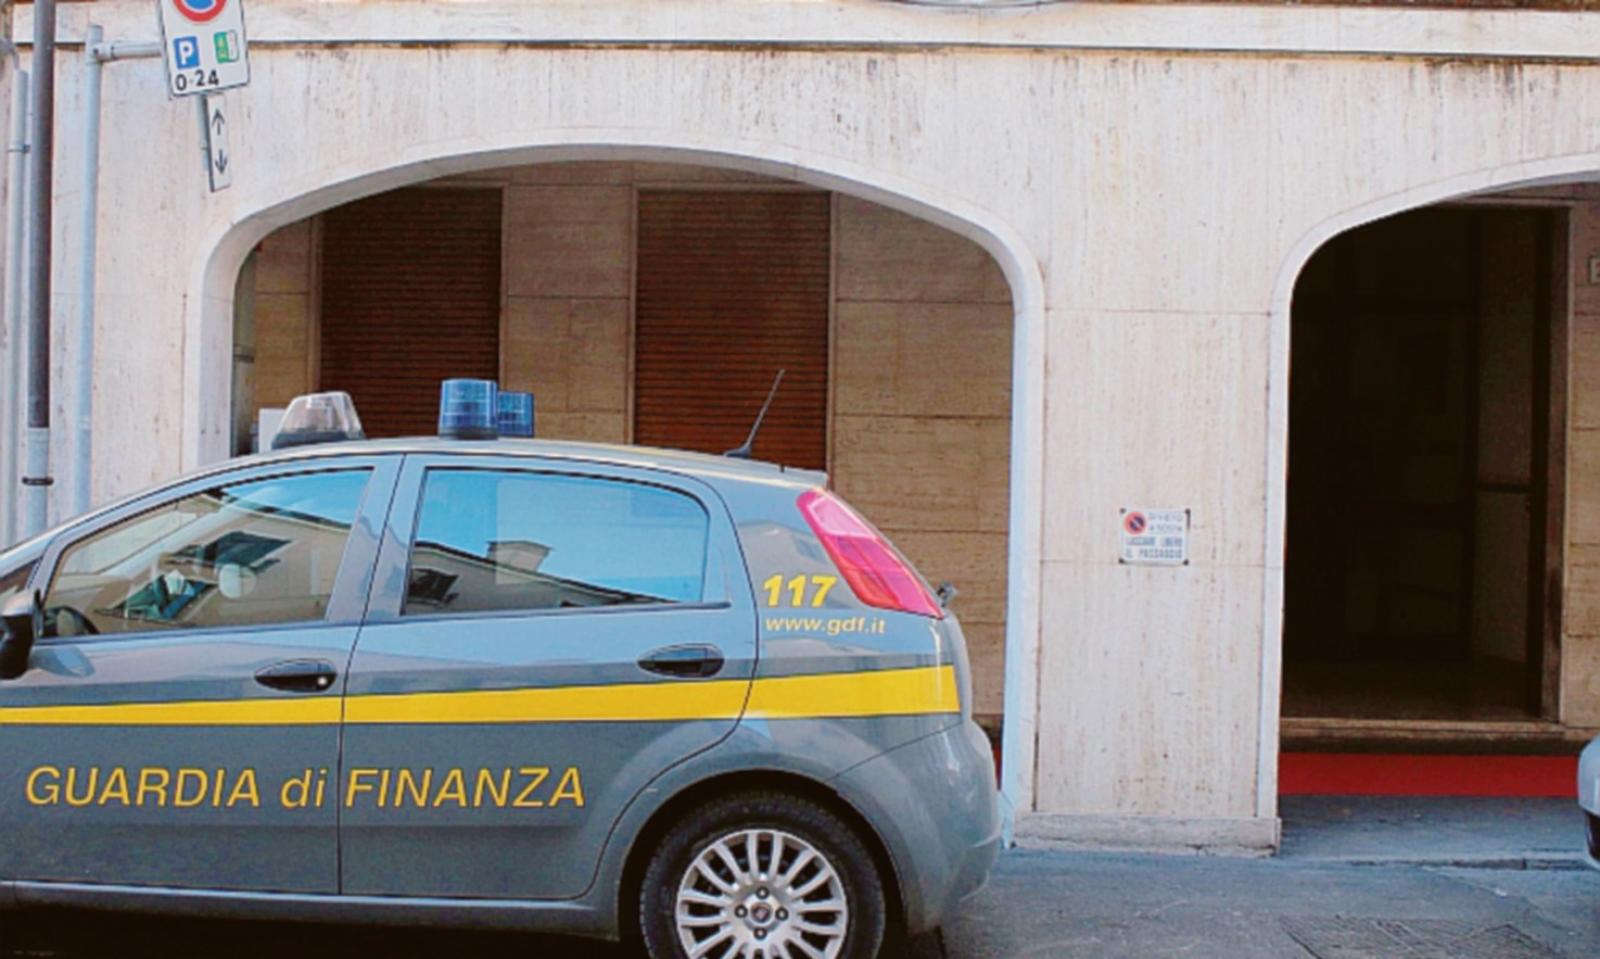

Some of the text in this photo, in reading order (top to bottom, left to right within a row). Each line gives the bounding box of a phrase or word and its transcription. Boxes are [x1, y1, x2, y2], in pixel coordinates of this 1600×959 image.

[179, 40, 193, 65] P
[763, 574, 837, 608] 117
[765, 616, 886, 636] www.gdf.it
[25, 765, 586, 809] GUARDIA di FINANZA
